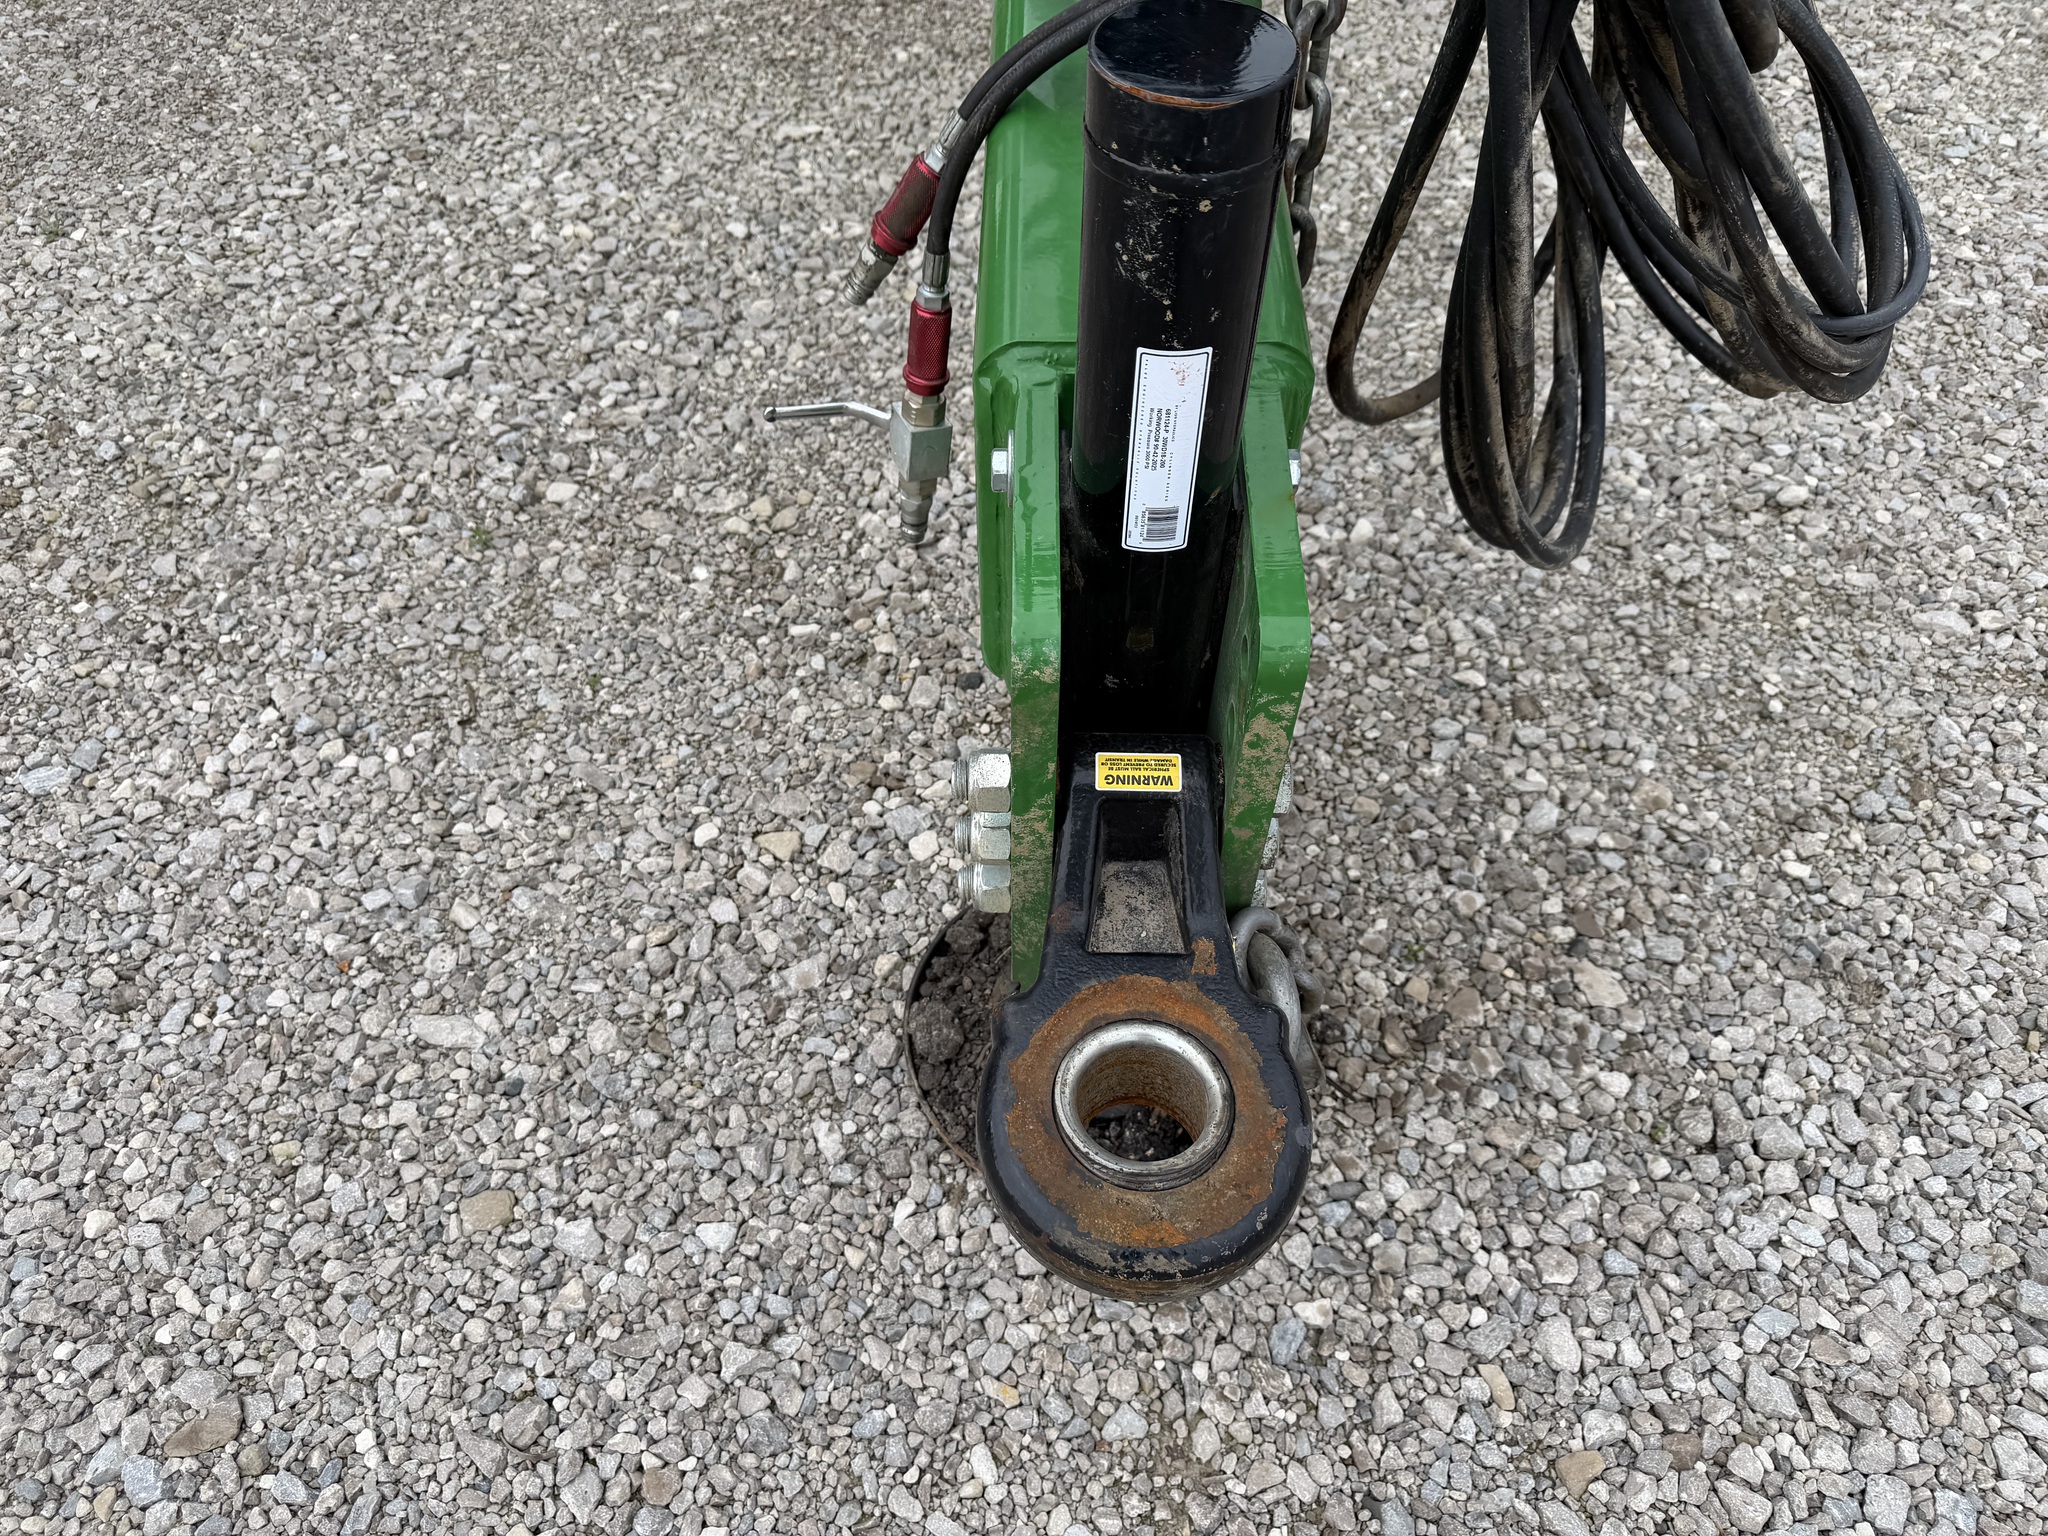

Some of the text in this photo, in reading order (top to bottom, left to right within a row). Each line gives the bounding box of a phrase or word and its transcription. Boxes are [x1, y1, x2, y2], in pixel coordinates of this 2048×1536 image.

[1147, 407, 1155, 428] Working
[1163, 408, 1172, 434] 681124-P
[1104, 774, 1174, 786] WARNING
